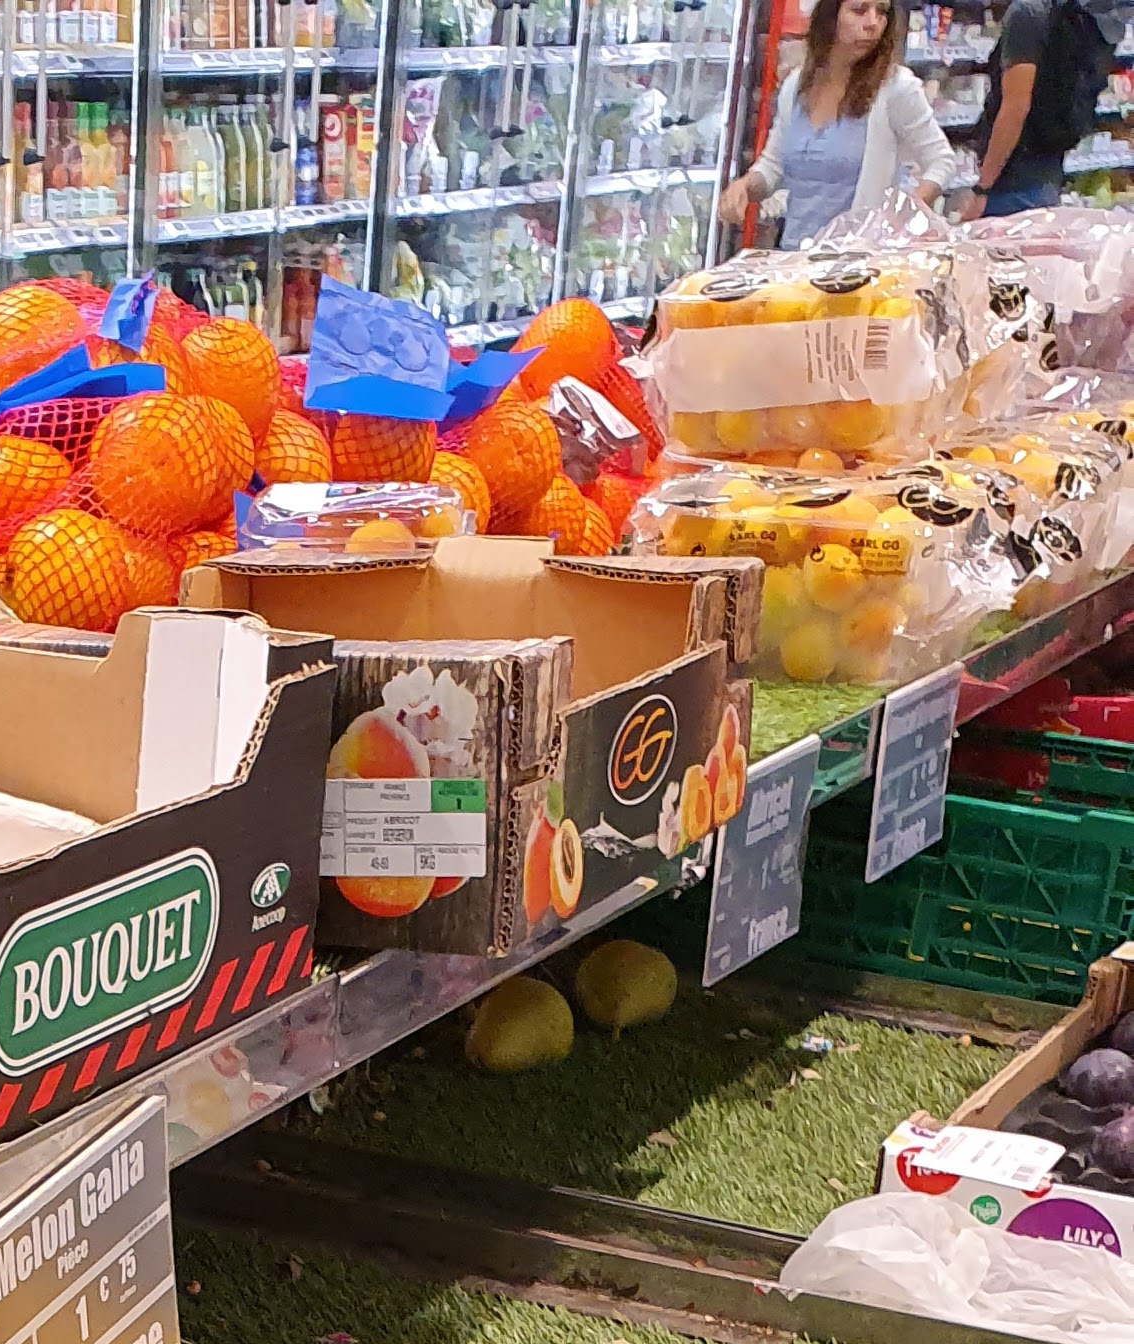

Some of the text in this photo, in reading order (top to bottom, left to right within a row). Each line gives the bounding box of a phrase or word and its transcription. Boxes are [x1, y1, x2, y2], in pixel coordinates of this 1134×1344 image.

[850, 538, 878, 551] SARL
[383, 816, 421, 825] ABRICOT
[11, 889, 202, 1036] BOUQUET
[79, 1139, 145, 1228] Galia
[1062, 1224, 1103, 1247] LILY
[56, 1239, 89, 1280] Pièce
[75, 1294, 90, 1342] 1
[118, 1247, 137, 1285] 75
